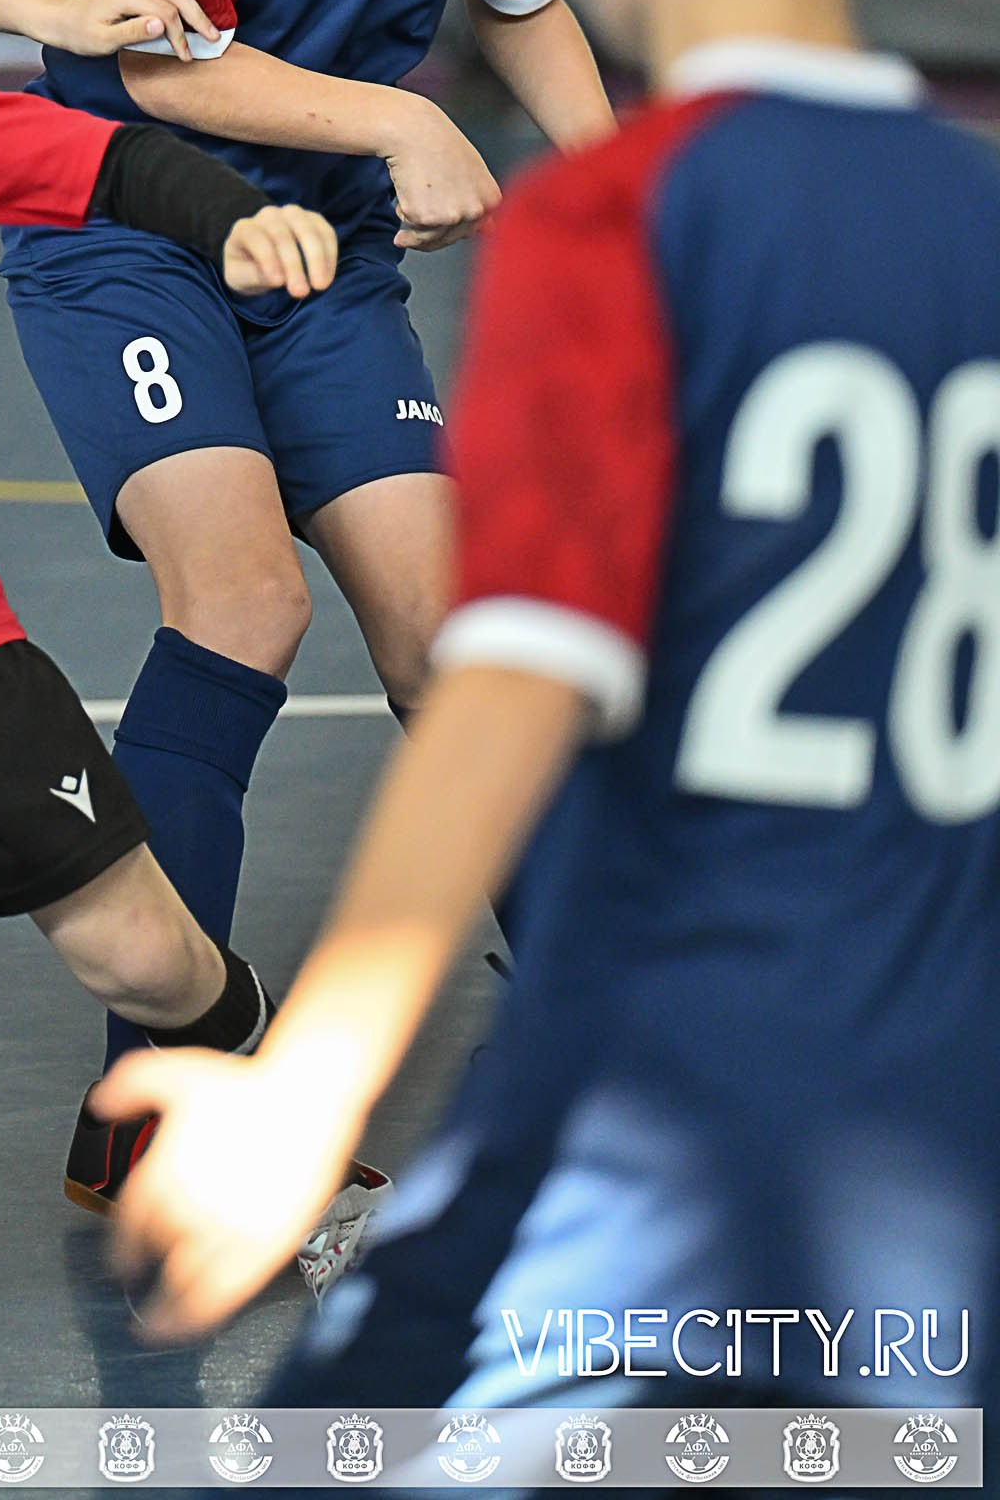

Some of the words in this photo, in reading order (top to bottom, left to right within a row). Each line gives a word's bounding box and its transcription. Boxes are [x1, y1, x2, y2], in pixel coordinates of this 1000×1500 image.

[122, 336, 183, 424] 8
[395, 399, 444, 427] JAKO
[673, 339, 1000, 827] 28
